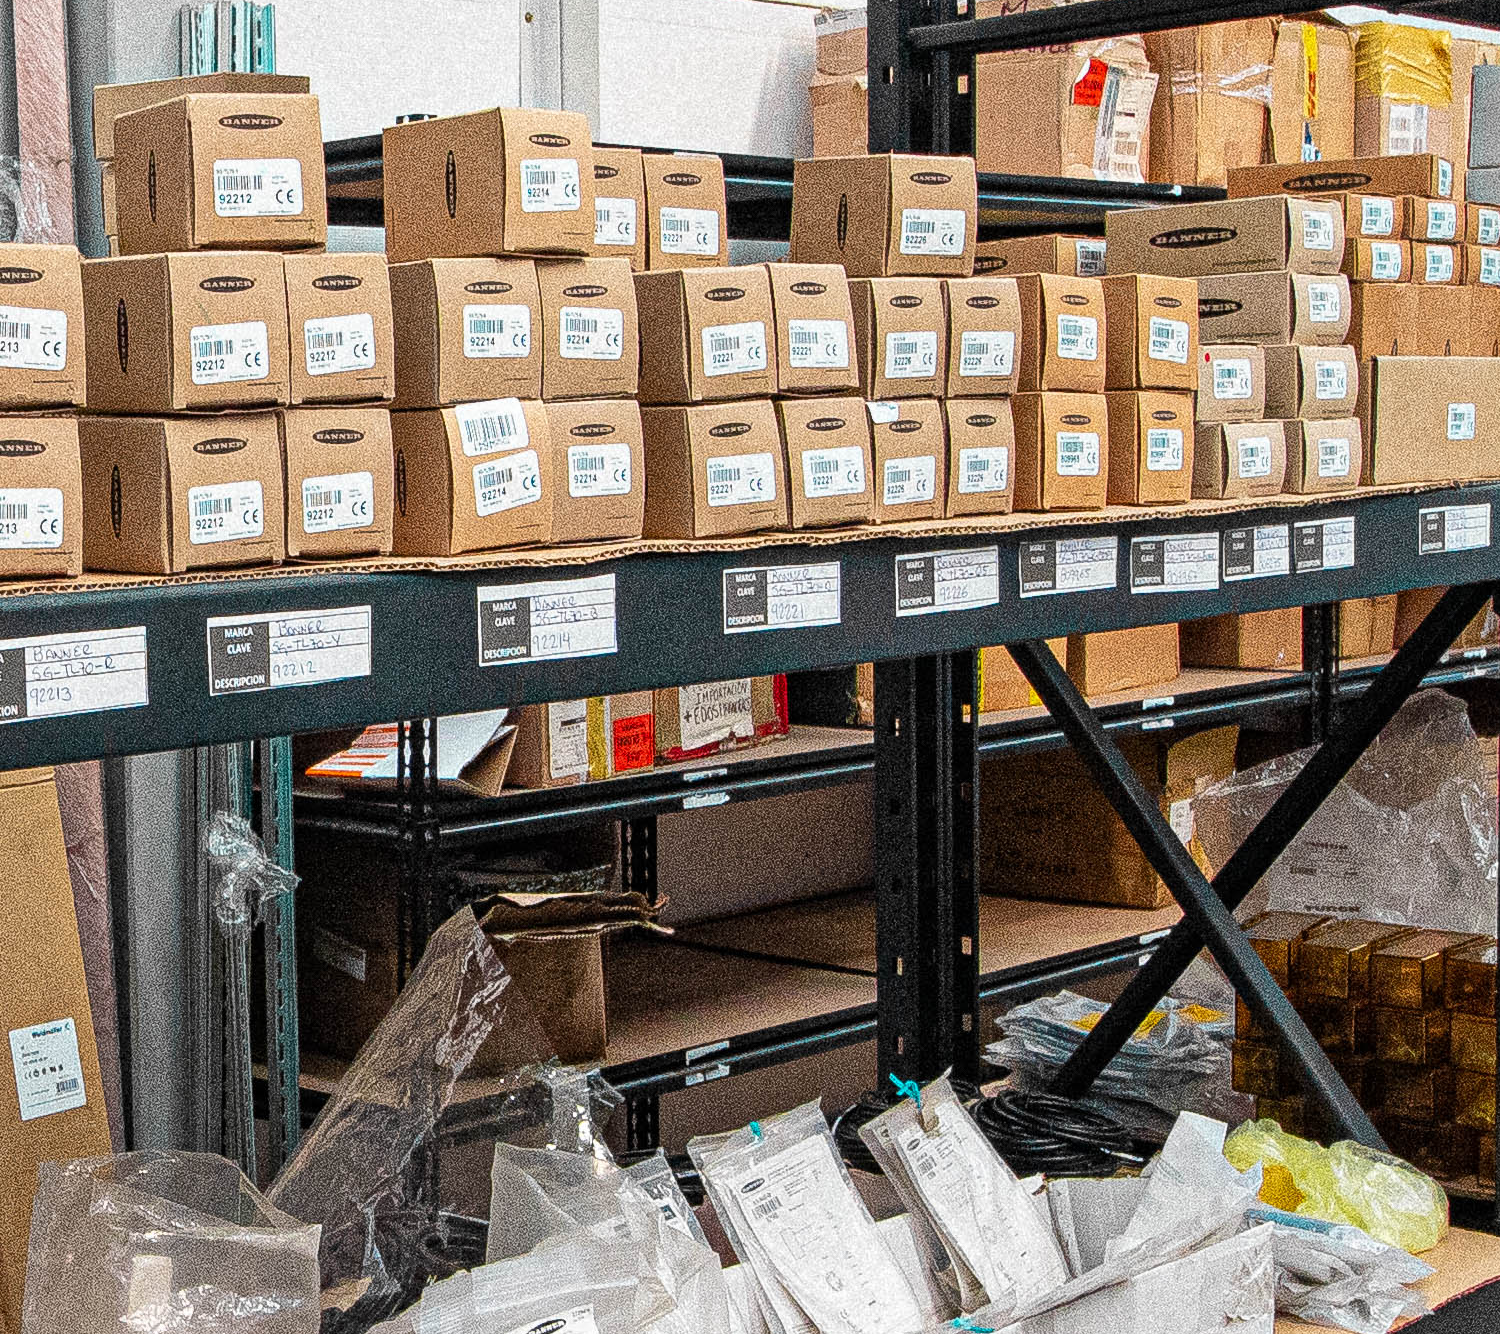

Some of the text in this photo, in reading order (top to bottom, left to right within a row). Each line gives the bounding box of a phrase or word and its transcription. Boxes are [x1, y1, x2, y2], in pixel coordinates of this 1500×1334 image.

[222, 115, 282, 128] BANNER
[218, 192, 253, 205] 92212
[201, 278, 254, 290] BANNER
[313, 277, 361, 289] BANNER
[469, 336, 496, 348] 92214
[566, 334, 591, 345] 92214
[309, 349, 336, 363] 92212
[195, 358, 225, 372] 92212
[313, 430, 362, 442] BANNER
[195, 440, 246, 452] BANNER
[573, 473, 598, 485] 92214
[306, 507, 334, 522] 92212
[195, 516, 224, 531] 92212
[492, 601, 517, 612] MARCA
[494, 615, 516, 628] CLAVE
[224, 627, 253, 638] MARCA
[226, 642, 251, 655] CLAVE
[484, 643, 527, 661] DESCRIPCION
[214, 674, 266, 690] DESCRIPCION
[29, 686, 73, 705] 92213
